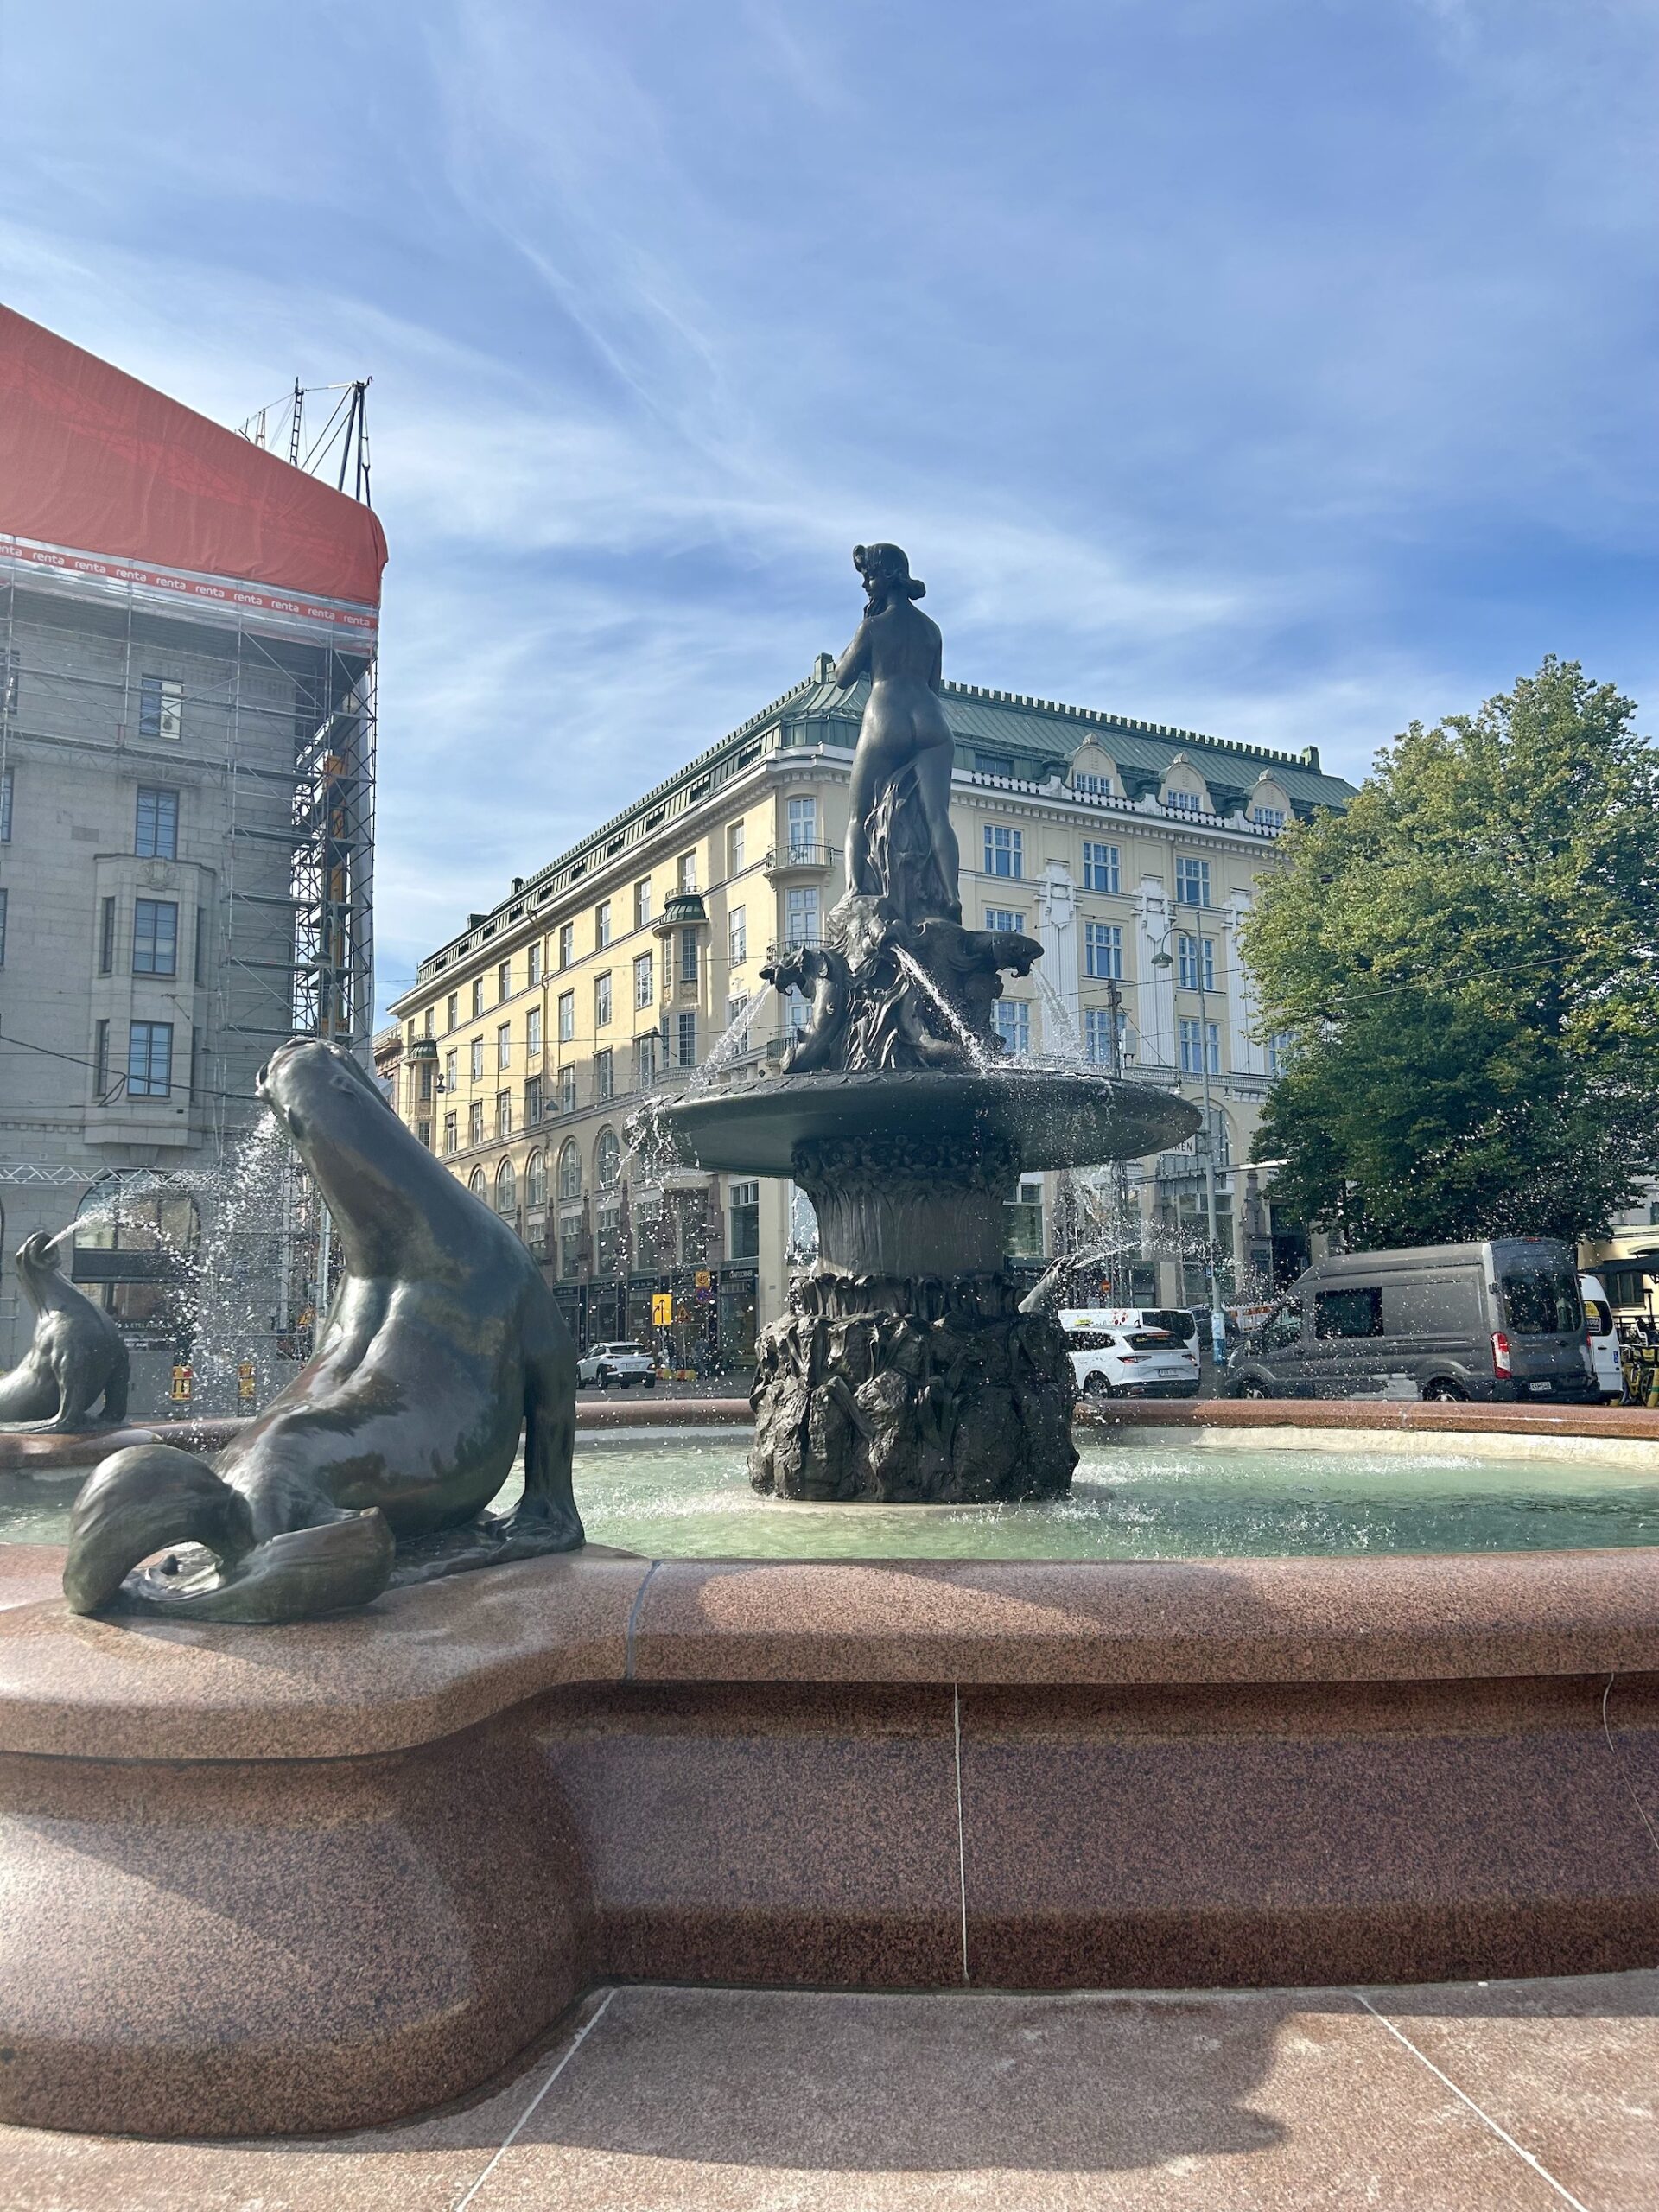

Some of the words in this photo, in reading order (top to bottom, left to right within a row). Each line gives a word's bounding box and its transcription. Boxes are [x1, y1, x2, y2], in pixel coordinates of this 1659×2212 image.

[0, 544, 22, 556] nta
[33, 552, 65, 565] renta
[74, 560, 106, 574] renta
[116, 569, 147, 582] renta
[156, 576, 186, 590] renta
[195, 585, 225, 598] renta
[233, 592, 263, 605] renta
[271, 600, 299, 613] renta
[308, 607, 335, 620] renta
[344, 615, 371, 626] renta
